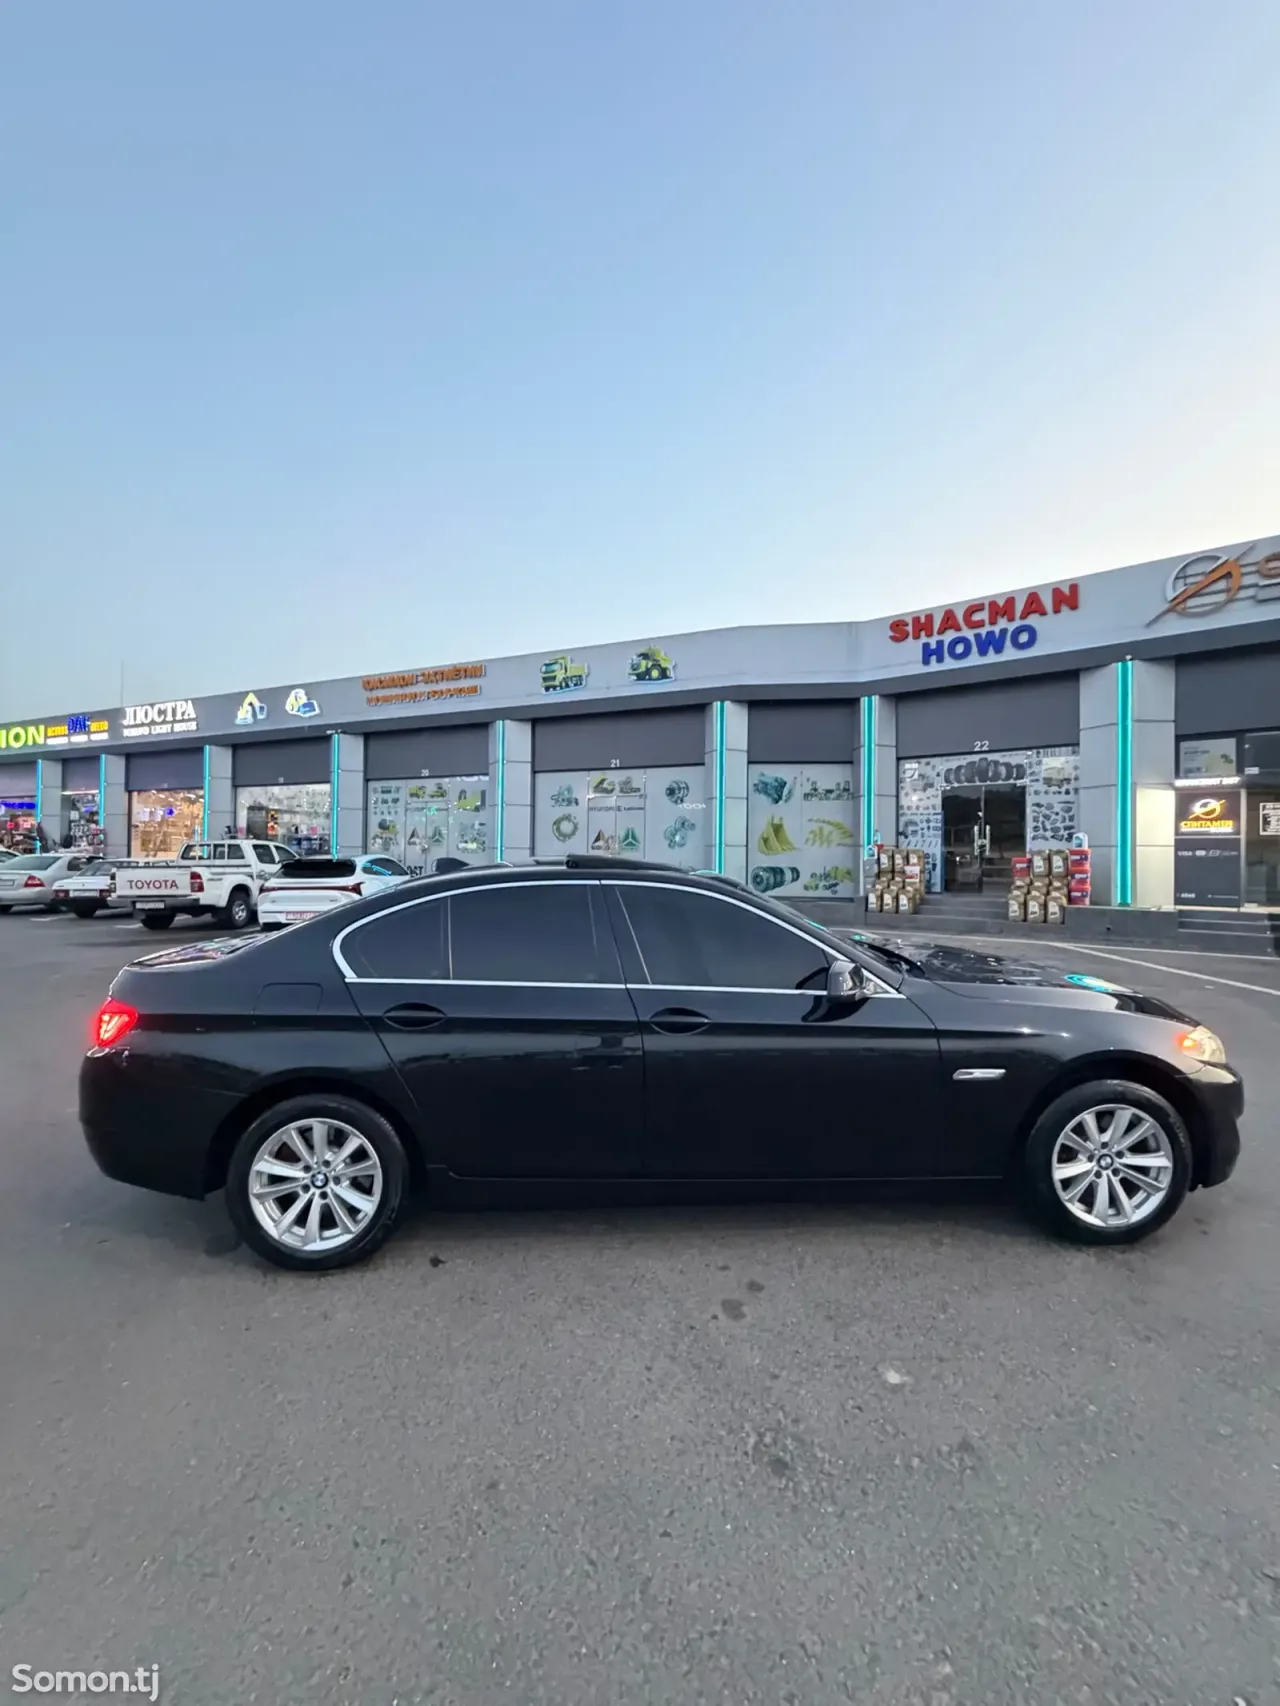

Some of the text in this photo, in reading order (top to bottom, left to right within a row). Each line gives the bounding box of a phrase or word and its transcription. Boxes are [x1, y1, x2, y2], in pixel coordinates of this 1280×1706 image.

[889, 583, 1079, 643] SHACMAN
[921, 624, 1038, 666] HOWO
[122, 700, 197, 727] ЛЮСТРА
[974, 740, 989, 752] 22
[610, 759, 620, 768] 21
[420, 769, 430, 777] 20
[127, 879, 178, 890] TOYOTA
